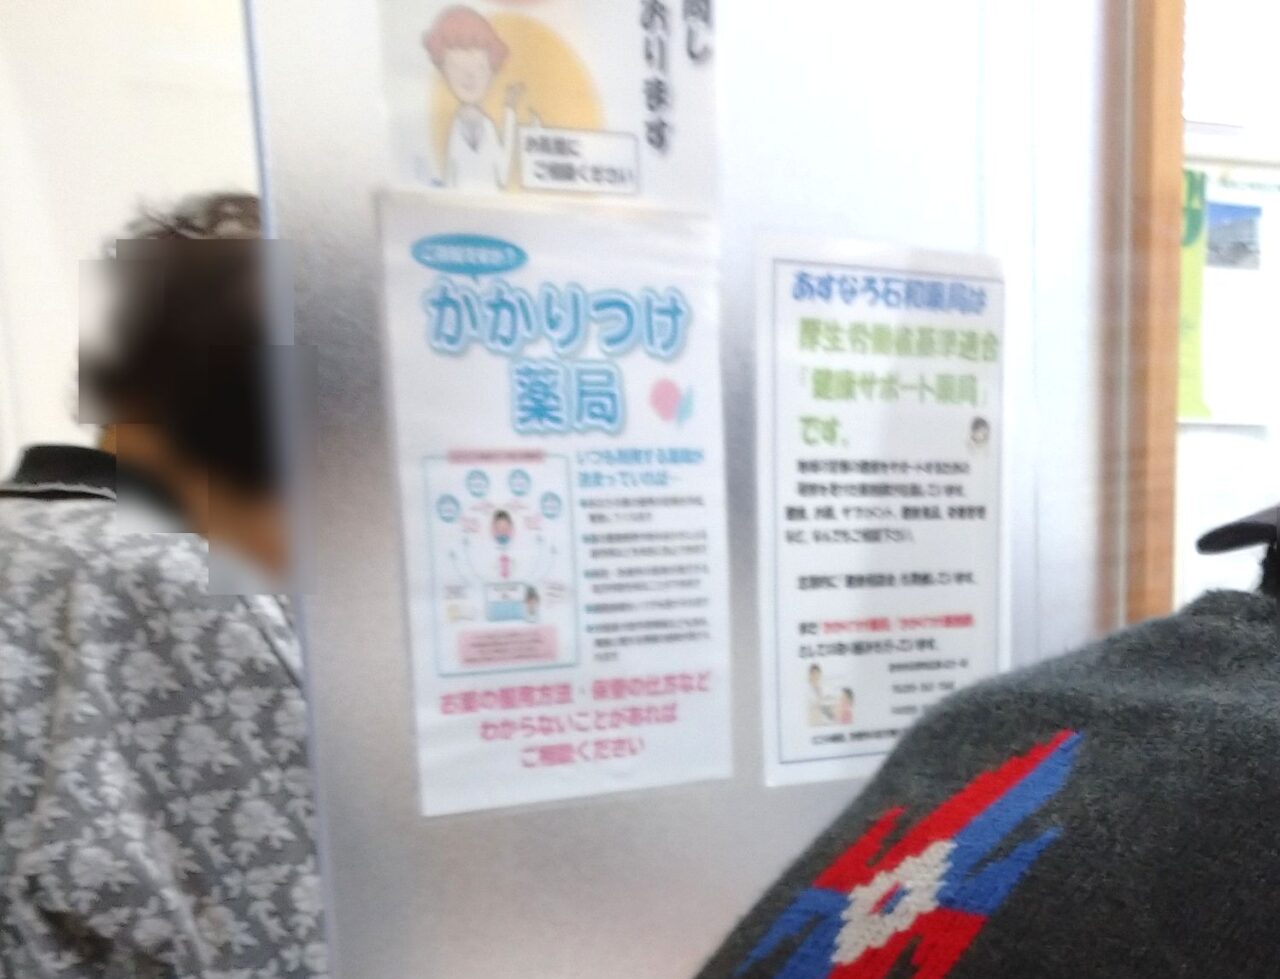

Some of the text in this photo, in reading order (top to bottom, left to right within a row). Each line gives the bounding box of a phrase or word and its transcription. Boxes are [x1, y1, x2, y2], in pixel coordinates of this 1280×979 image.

[424, 279, 692, 361] かかりつけ
[511, 356, 626, 434] 薬局
